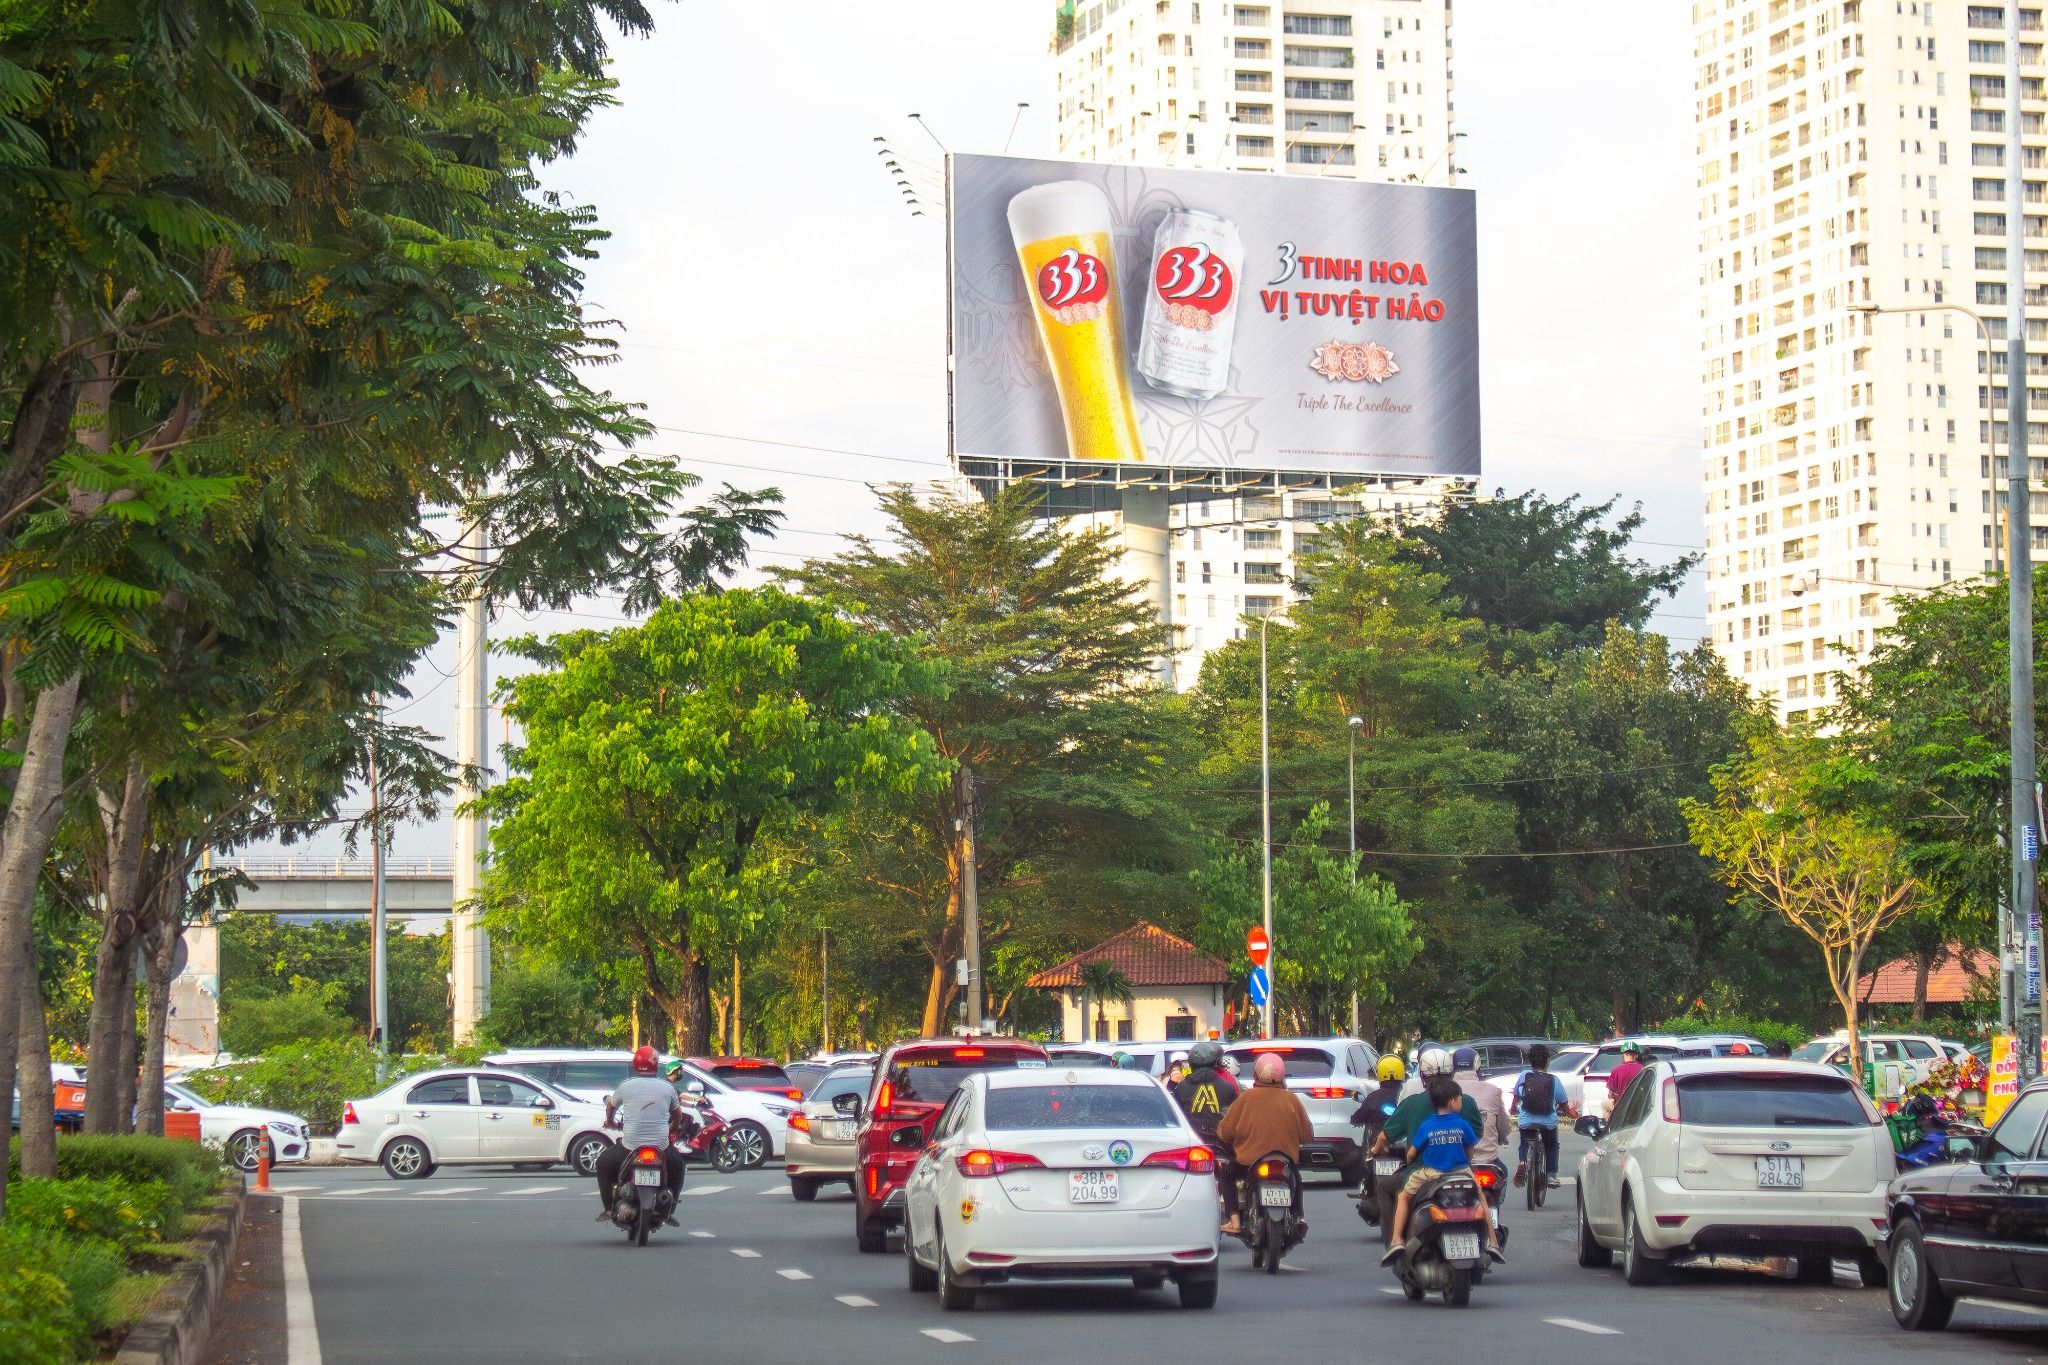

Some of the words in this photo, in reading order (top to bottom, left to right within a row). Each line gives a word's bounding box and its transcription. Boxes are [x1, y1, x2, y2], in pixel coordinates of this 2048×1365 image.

[1160, 242, 1225, 299] 333
[1267, 241, 1297, 285] 3
[1299, 255, 1363, 281] TINH
[1370, 260, 1429, 286] HOA
[1046, 248, 1099, 306] 333
[1260, 289, 1289, 321] VỊ
[1296, 288, 1380, 326] TUYỆT
[1388, 291, 1446, 322] HẢO
[1298, 392, 1329, 413] Triple
[1333, 394, 1353, 411] The
[1356, 396, 1413, 414] Excellence
[1768, 1159, 1791, 1171] 51A
[1081, 1171, 1106, 1185] 38A
[1760, 1172, 1801, 1186] 284.26
[1072, 1185, 1118, 1201] 204.99
